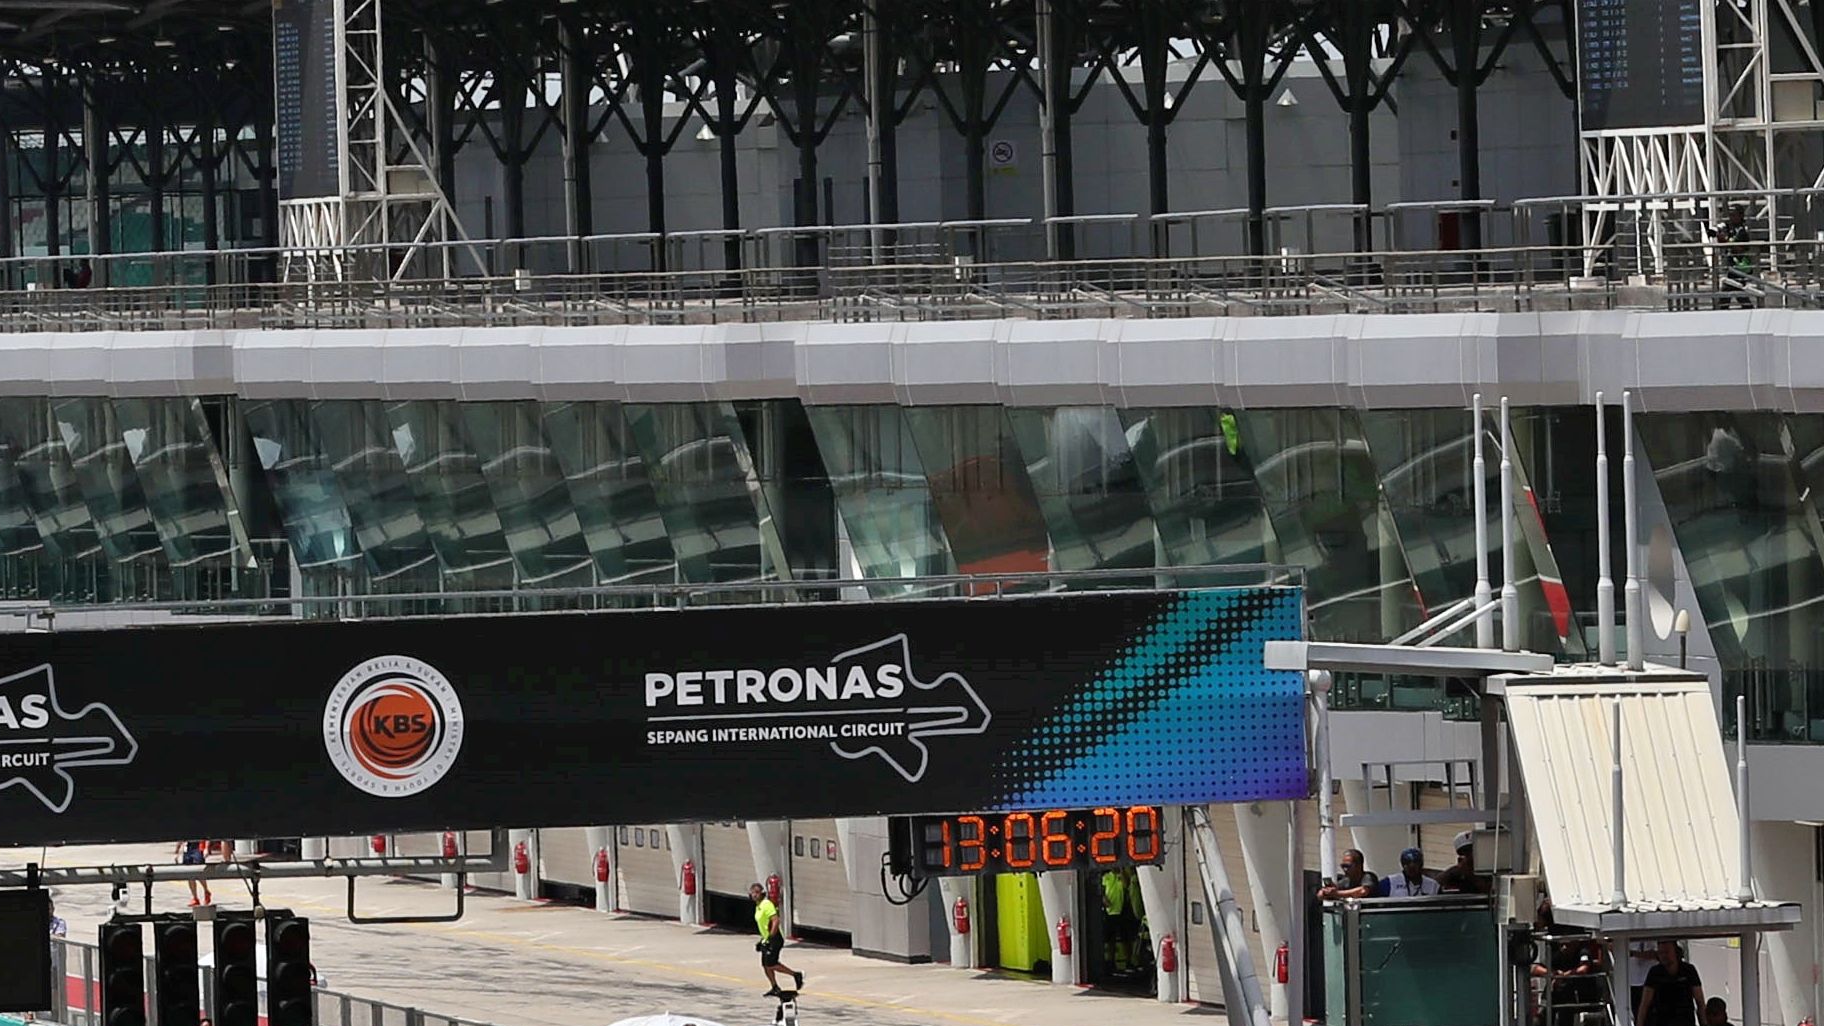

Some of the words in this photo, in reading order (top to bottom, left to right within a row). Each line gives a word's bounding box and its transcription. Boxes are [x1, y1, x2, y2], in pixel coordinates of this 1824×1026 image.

[644, 664, 904, 707] PETRONAS
[373, 714, 426, 739] KBS
[647, 730, 709, 745] SEPANG
[712, 725, 838, 742] INTERNATIONAL
[840, 723, 905, 738] CIRCUIT
[942, 806, 1159, 871] 13:06:20
